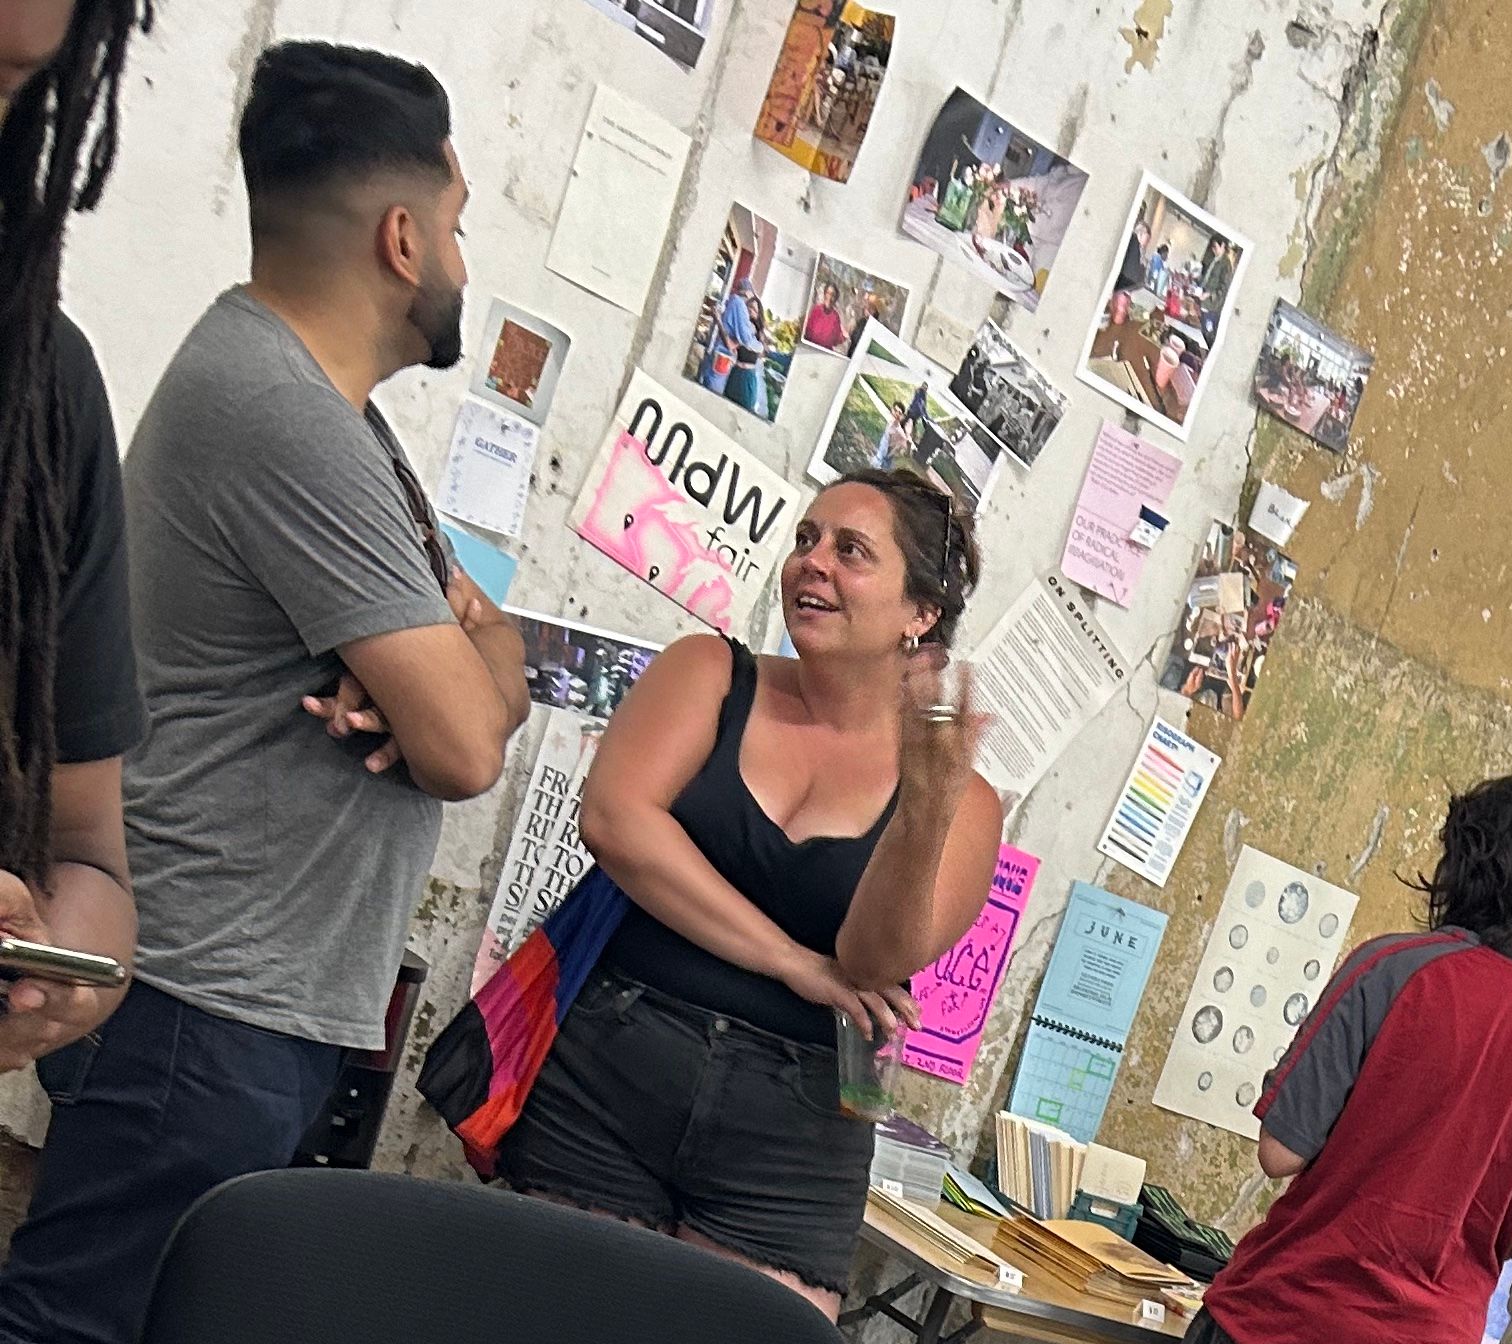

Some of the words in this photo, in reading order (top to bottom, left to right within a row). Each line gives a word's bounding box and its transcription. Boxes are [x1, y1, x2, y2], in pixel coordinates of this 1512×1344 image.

[705, 526, 760, 582] fair
[1048, 576, 1066, 597] ON
[1066, 601, 1125, 680] SPLITTING
[553, 843, 585, 879] TO
[1083, 920, 1139, 950] JUNE
